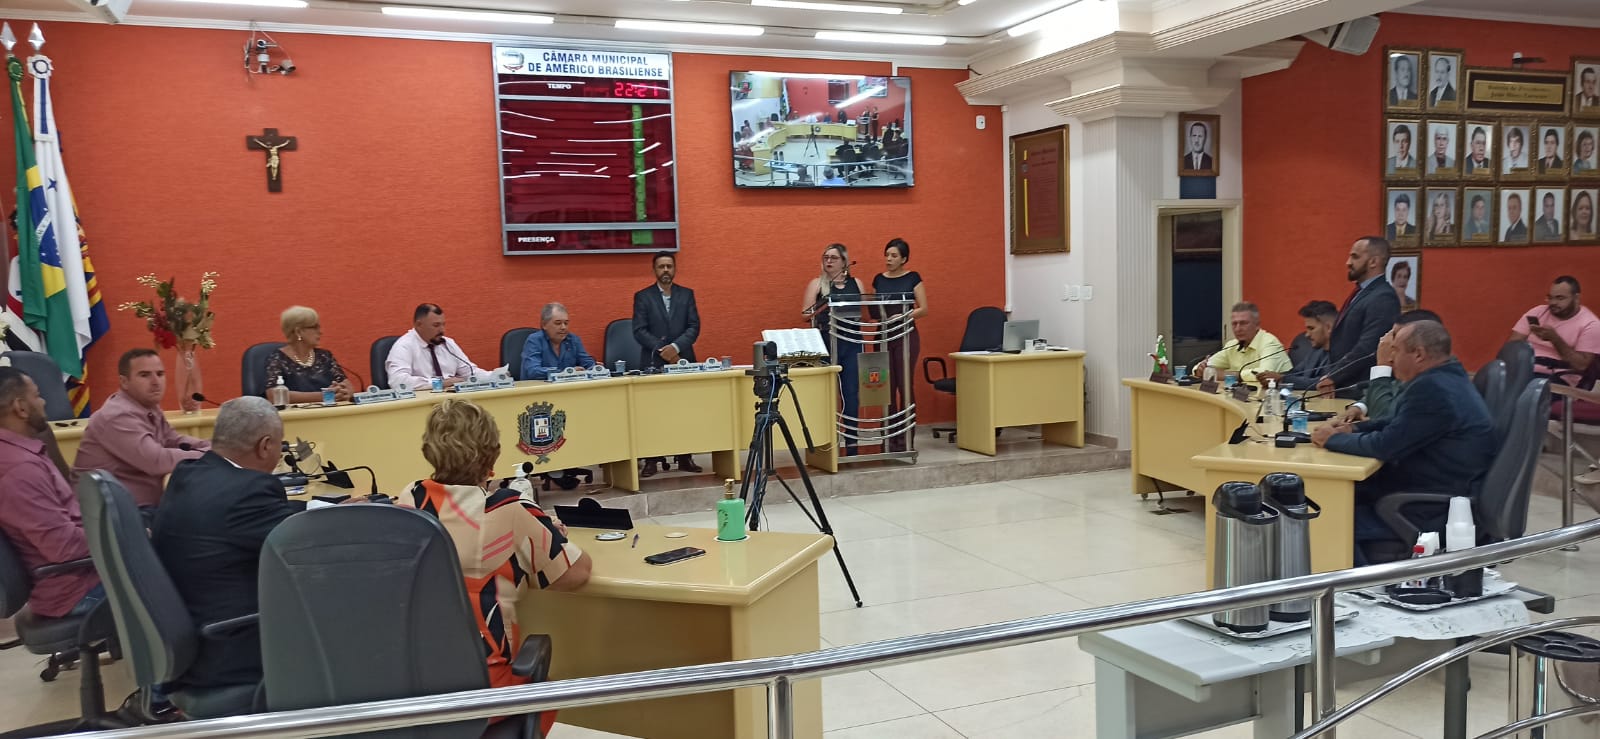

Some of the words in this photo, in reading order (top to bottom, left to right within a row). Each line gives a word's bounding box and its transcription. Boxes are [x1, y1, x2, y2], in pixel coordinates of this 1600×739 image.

[543, 51, 588, 62] CÂMARA
[592, 54, 648, 66] MUNICIPAL
[528, 62, 542, 72] DE
[598, 65, 663, 77] BRASILIENSE
